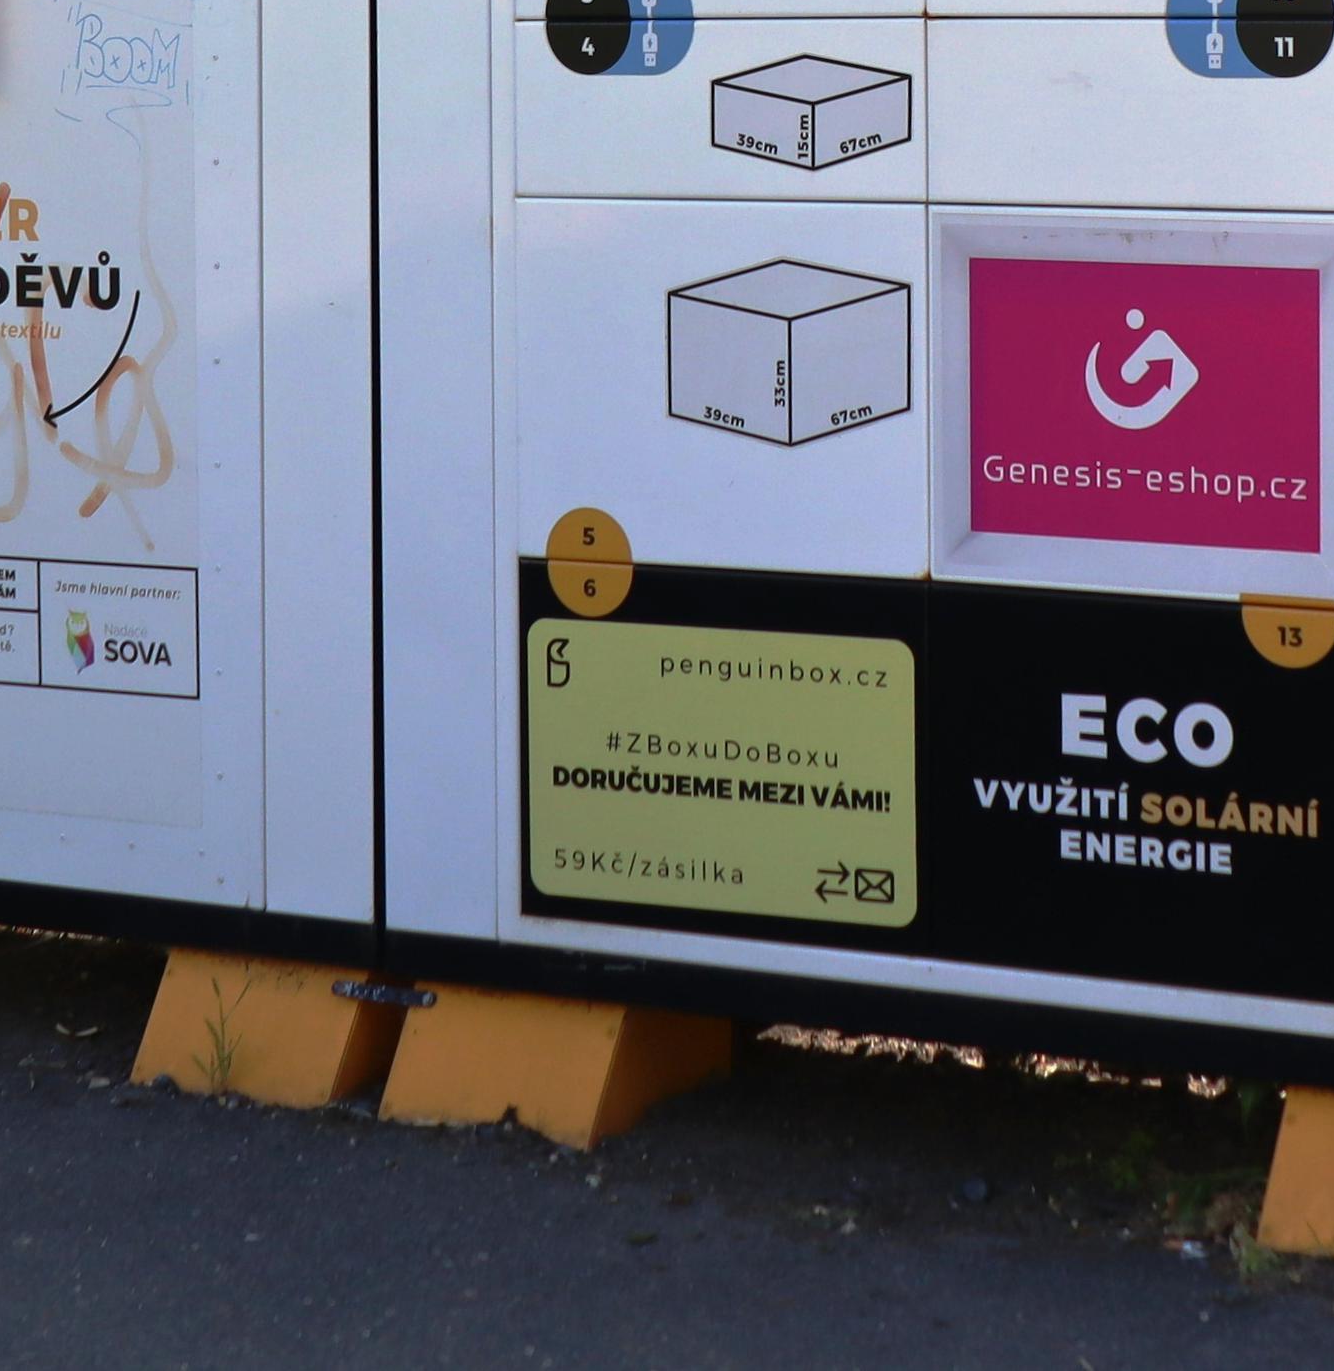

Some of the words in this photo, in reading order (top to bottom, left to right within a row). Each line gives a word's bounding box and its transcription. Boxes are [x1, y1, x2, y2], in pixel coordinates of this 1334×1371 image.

[580, 36, 595, 57] 4
[1274, 36, 1294, 57] 11
[736, 132, 779, 156] 39cm
[797, 113, 810, 160] 15cm
[839, 131, 883, 155] 67cm
[0, 320, 62, 340] textilu
[774, 360, 786, 408] 33cm
[703, 405, 745, 429] 39cm
[830, 404, 874, 427] 67cm
[983, 454, 1308, 504] Genesis-eshop.cz
[582, 527, 595, 546] 5
[55, 580, 86, 594] Jsme
[89, 581, 129, 596] hlavní
[583, 578, 597, 598] 6
[1277, 626, 1303, 648] 13
[104, 638, 173, 667] SOVA
[660, 655, 889, 689] penguinbox.cz
[1060, 692, 1235, 769] ECO
[606, 731, 840, 770] #ZBoxuDoBoxu
[552, 764, 733, 801] DORUČUJEME
[738, 779, 805, 806] MEZI
[811, 782, 891, 813] VÁMI!
[972, 776, 1130, 822] VYUŽITÍ
[1140, 791, 1320, 839] SOLÁRNÍ
[1060, 829, 1233, 876] ENERGIE
[554, 848, 745, 885] 59Kč/zásilka
